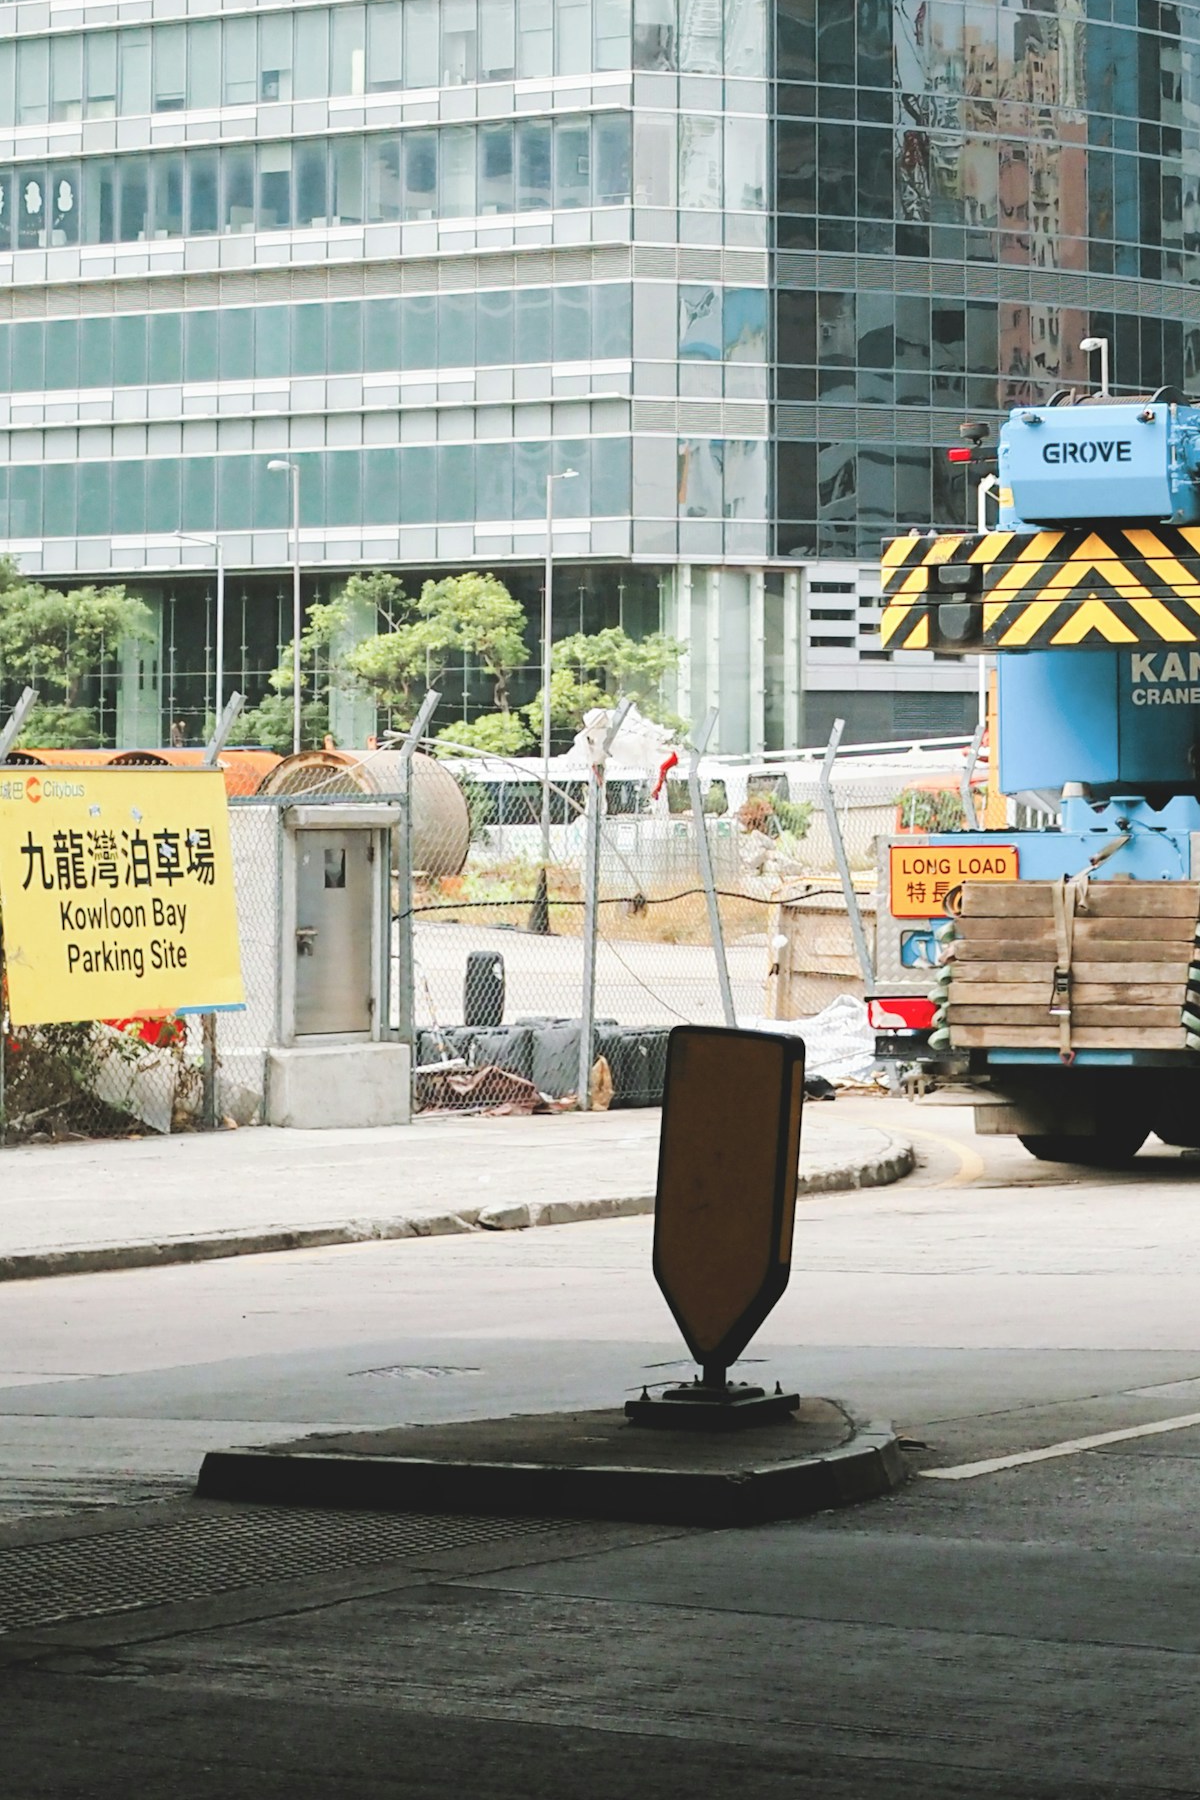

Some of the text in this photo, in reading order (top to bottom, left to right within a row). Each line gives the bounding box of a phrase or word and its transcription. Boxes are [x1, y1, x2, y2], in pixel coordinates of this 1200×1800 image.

[1042, 440, 1132, 464] GROVE
[43, 779, 86, 800] Citybus
[20, 828, 215, 890] 九龍灣泊車場
[902, 857, 1006, 875] LONG LOAD
[60, 897, 187, 935] Kowloon Bay
[67, 939, 188, 978] Parking Site
